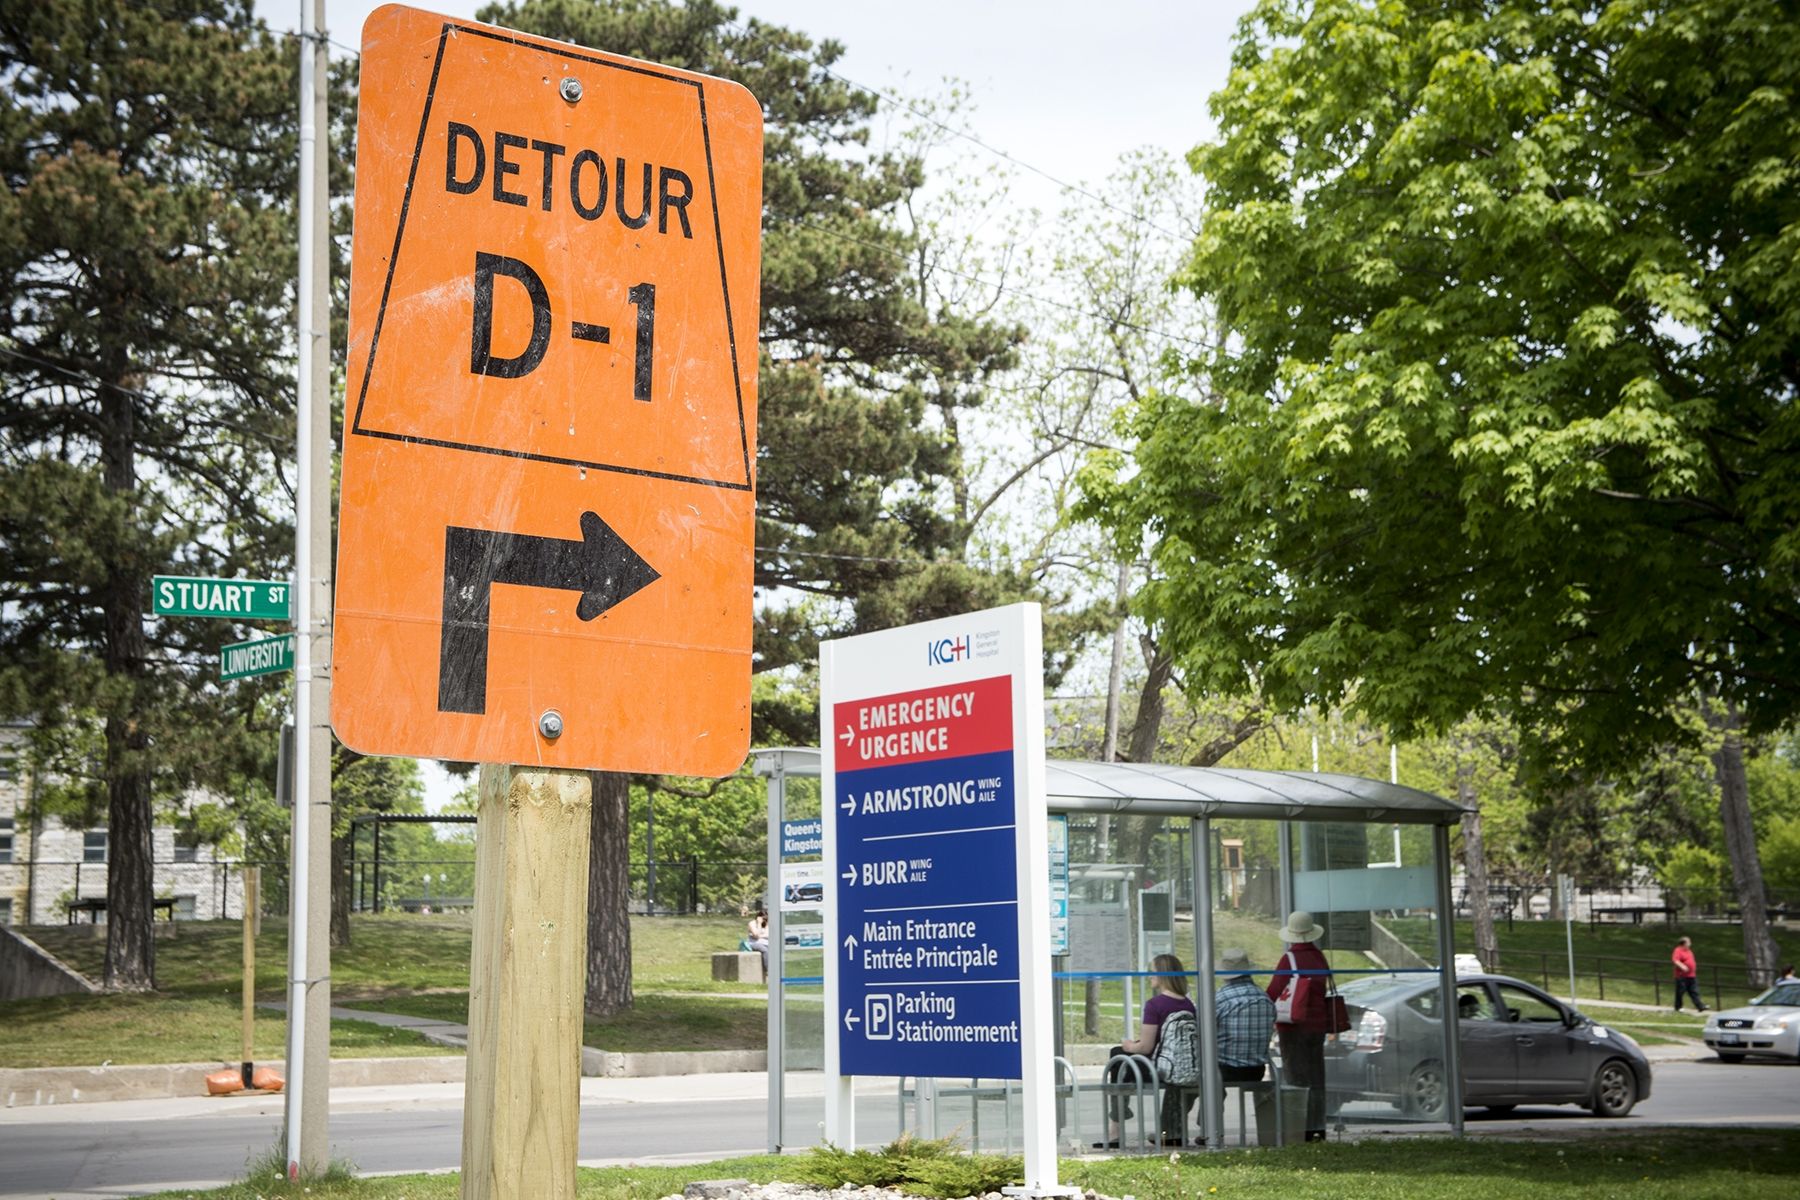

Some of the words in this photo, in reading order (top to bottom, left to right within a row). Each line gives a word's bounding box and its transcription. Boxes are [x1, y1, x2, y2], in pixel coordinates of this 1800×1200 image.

[446, 121, 693, 238] DETOUR
[471, 251, 656, 402] D-1
[159, 582, 255, 612] STUART
[268, 587, 285, 603] ST
[859, 692, 975, 730] EMERGENCY
[860, 727, 948, 760] URGENCE
[861, 780, 975, 815] ARMSTRONG
[978, 777, 1001, 789] WING
[978, 791, 996, 802] AILE
[784, 821, 822, 836] Queen's
[862, 860, 908, 886] BURR
[910, 858, 932, 870] WING
[910, 872, 927, 882] AILE
[863, 920, 902, 942] Main
[906, 919, 976, 941] Entrance
[864, 947, 912, 969] Entrée
[916, 943, 998, 973] Principale
[872, 1002, 887, 1032] P
[896, 991, 955, 1020] Parking
[897, 1020, 1018, 1042] Stationnement
